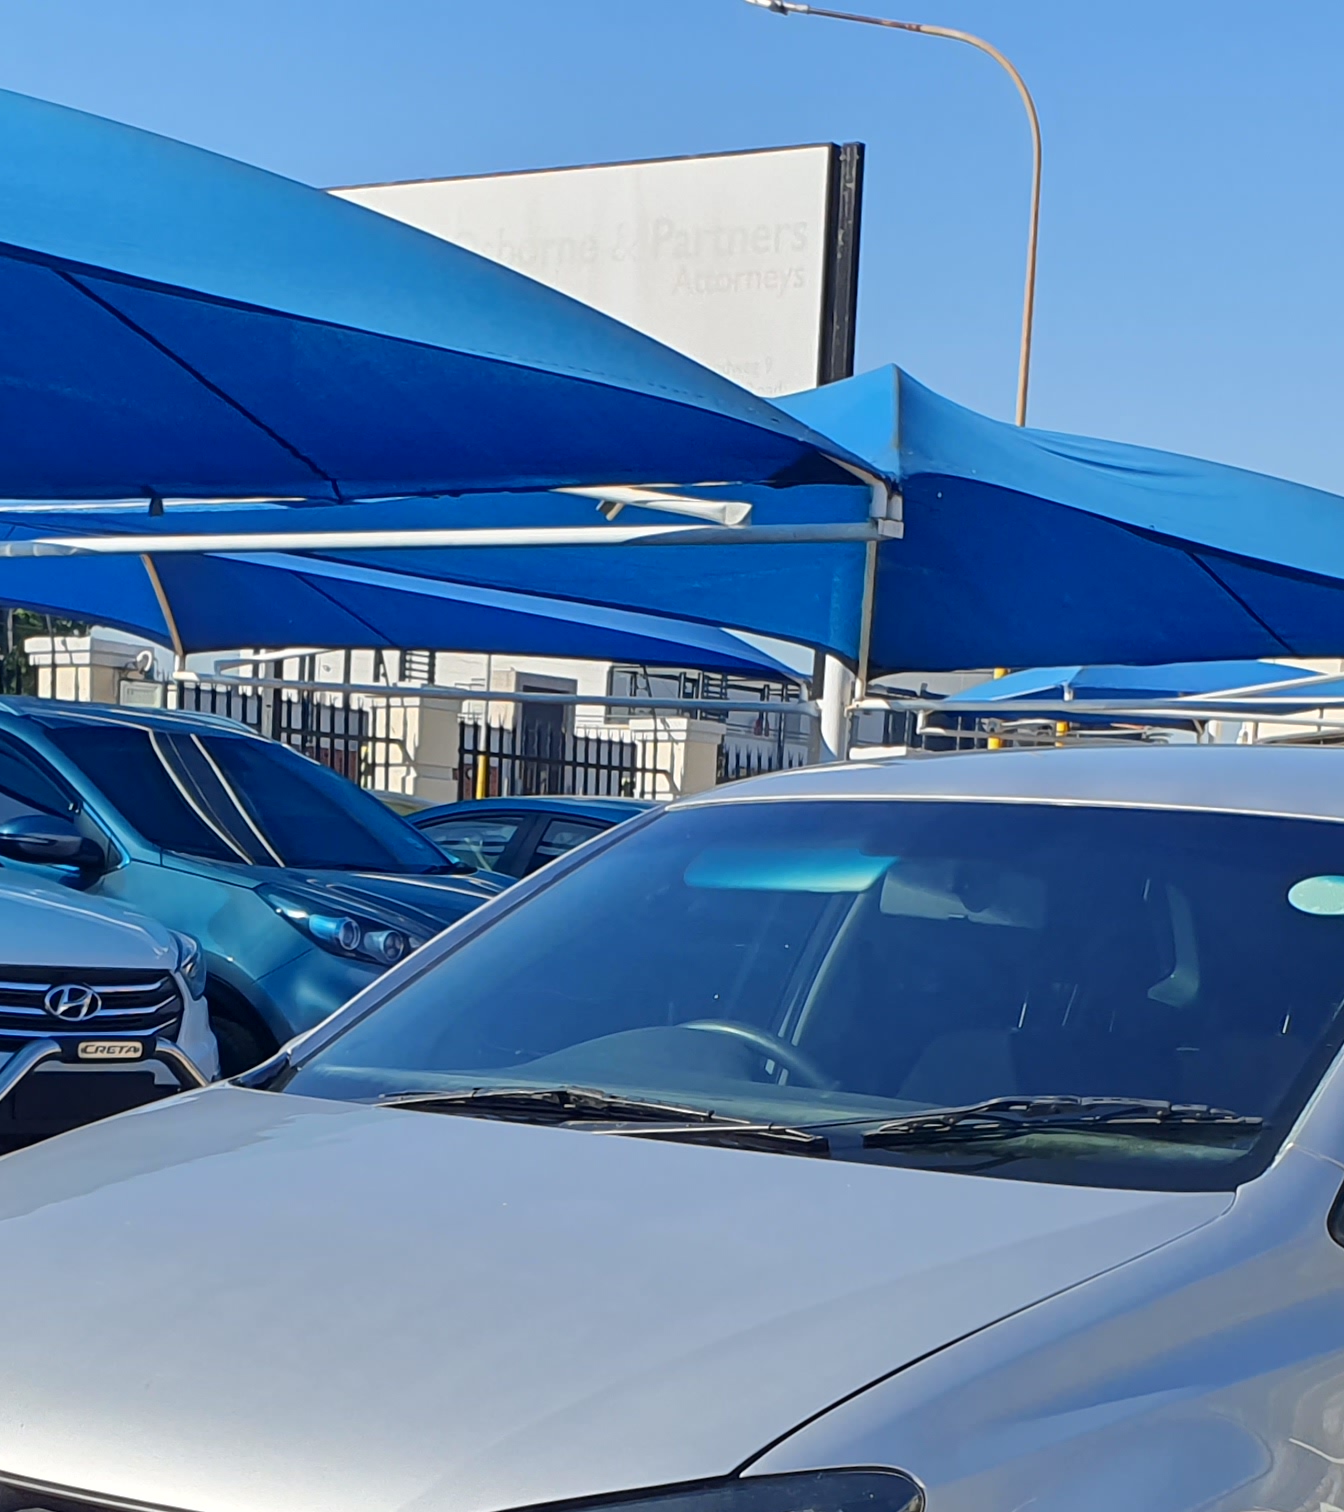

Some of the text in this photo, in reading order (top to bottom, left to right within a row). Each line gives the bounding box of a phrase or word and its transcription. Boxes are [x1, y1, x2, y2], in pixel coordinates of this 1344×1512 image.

[651, 217, 808, 260] Partners
[670, 265, 805, 299] Attorneys
[82, 1044, 139, 1054] CRETA
